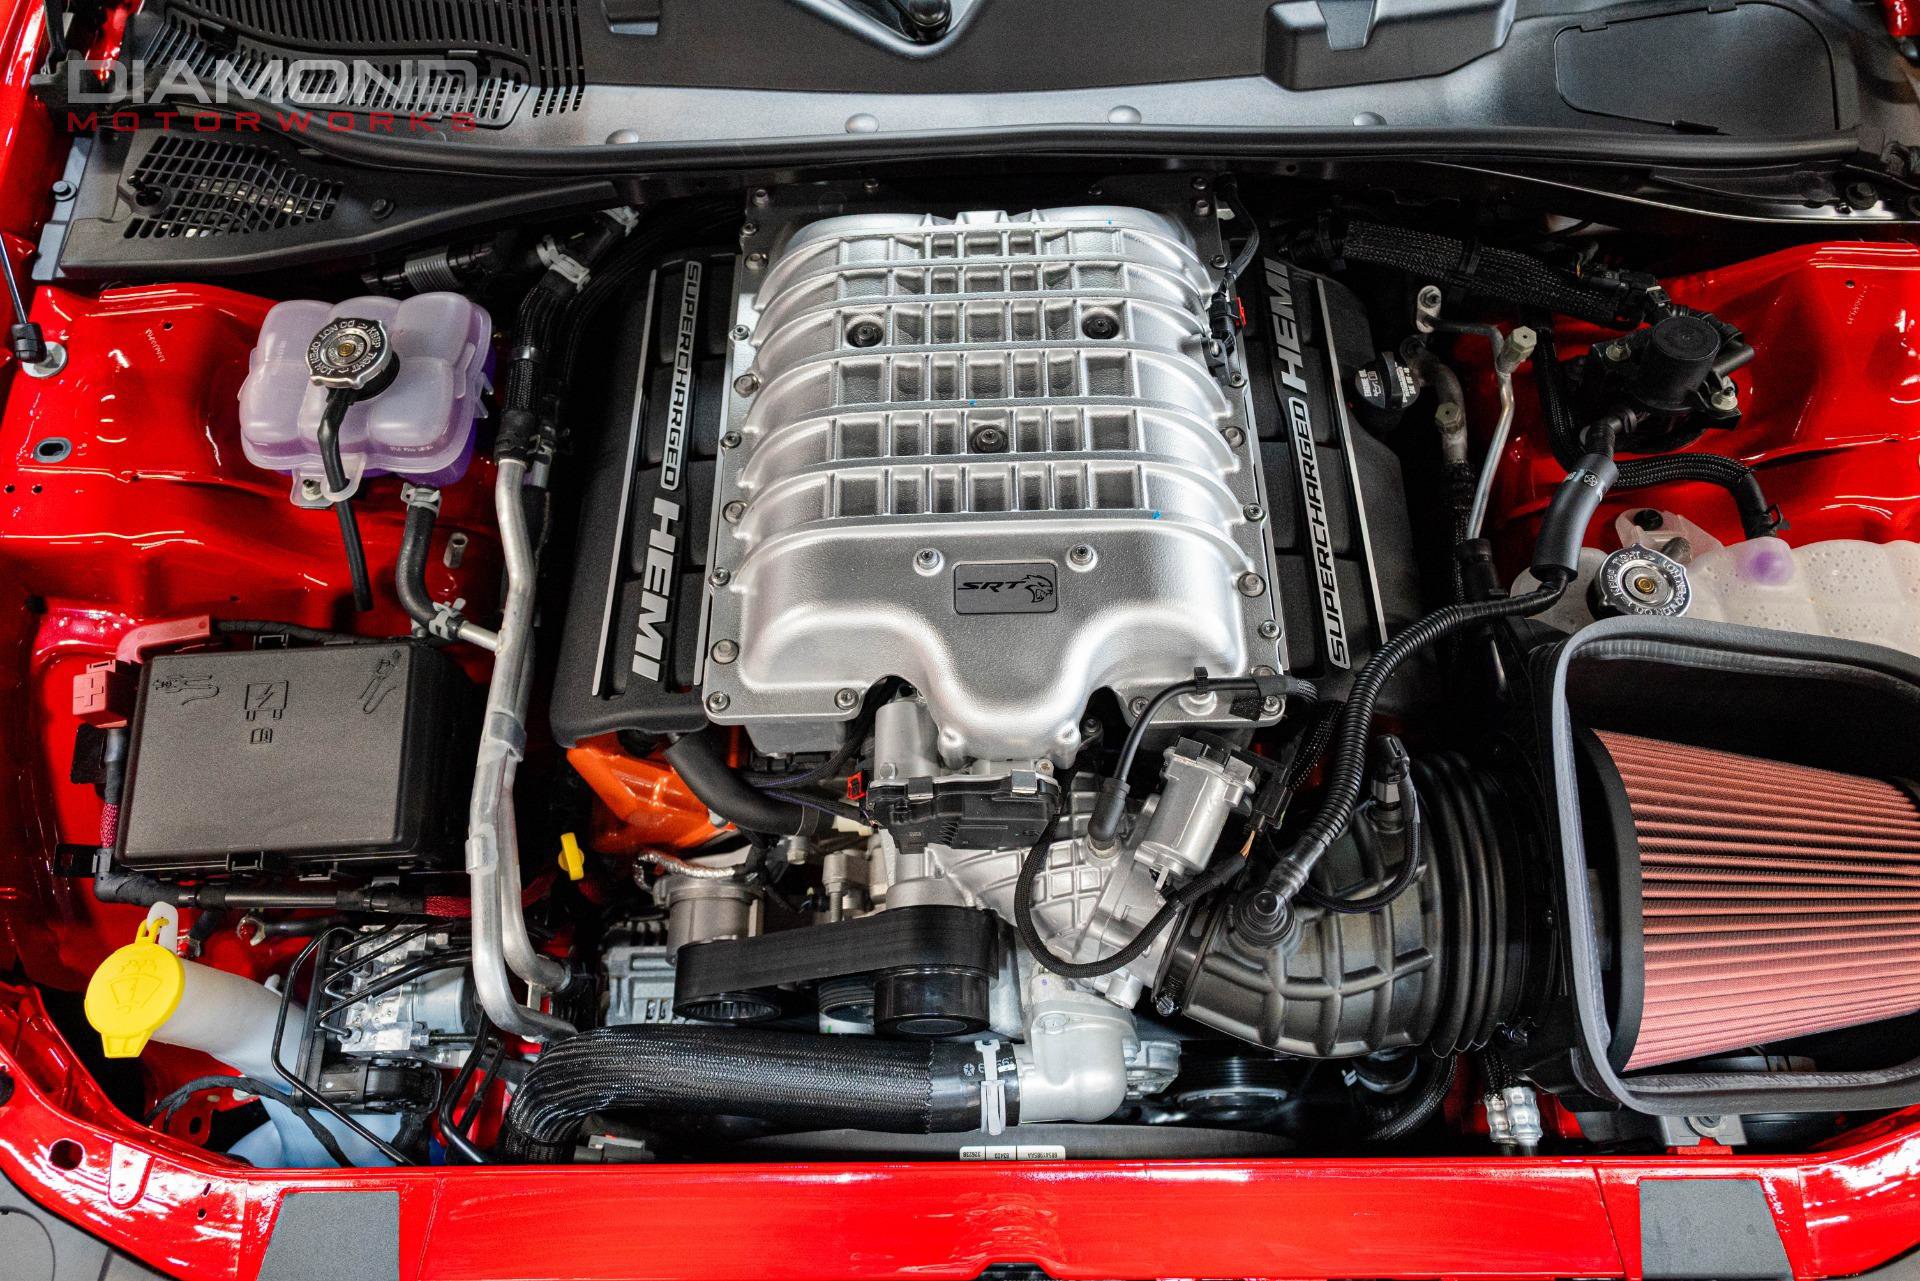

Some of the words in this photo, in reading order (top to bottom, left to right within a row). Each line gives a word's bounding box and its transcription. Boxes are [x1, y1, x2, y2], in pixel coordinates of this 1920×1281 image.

[367, 326, 381, 348] KEEP
[663, 261, 699, 490] SUPERCHARGED
[1264, 256, 1308, 394] HEMI
[632, 497, 680, 681] HEMI
[957, 580, 1026, 593] SRT
[1292, 399, 1349, 669] SUPERCHARGED
